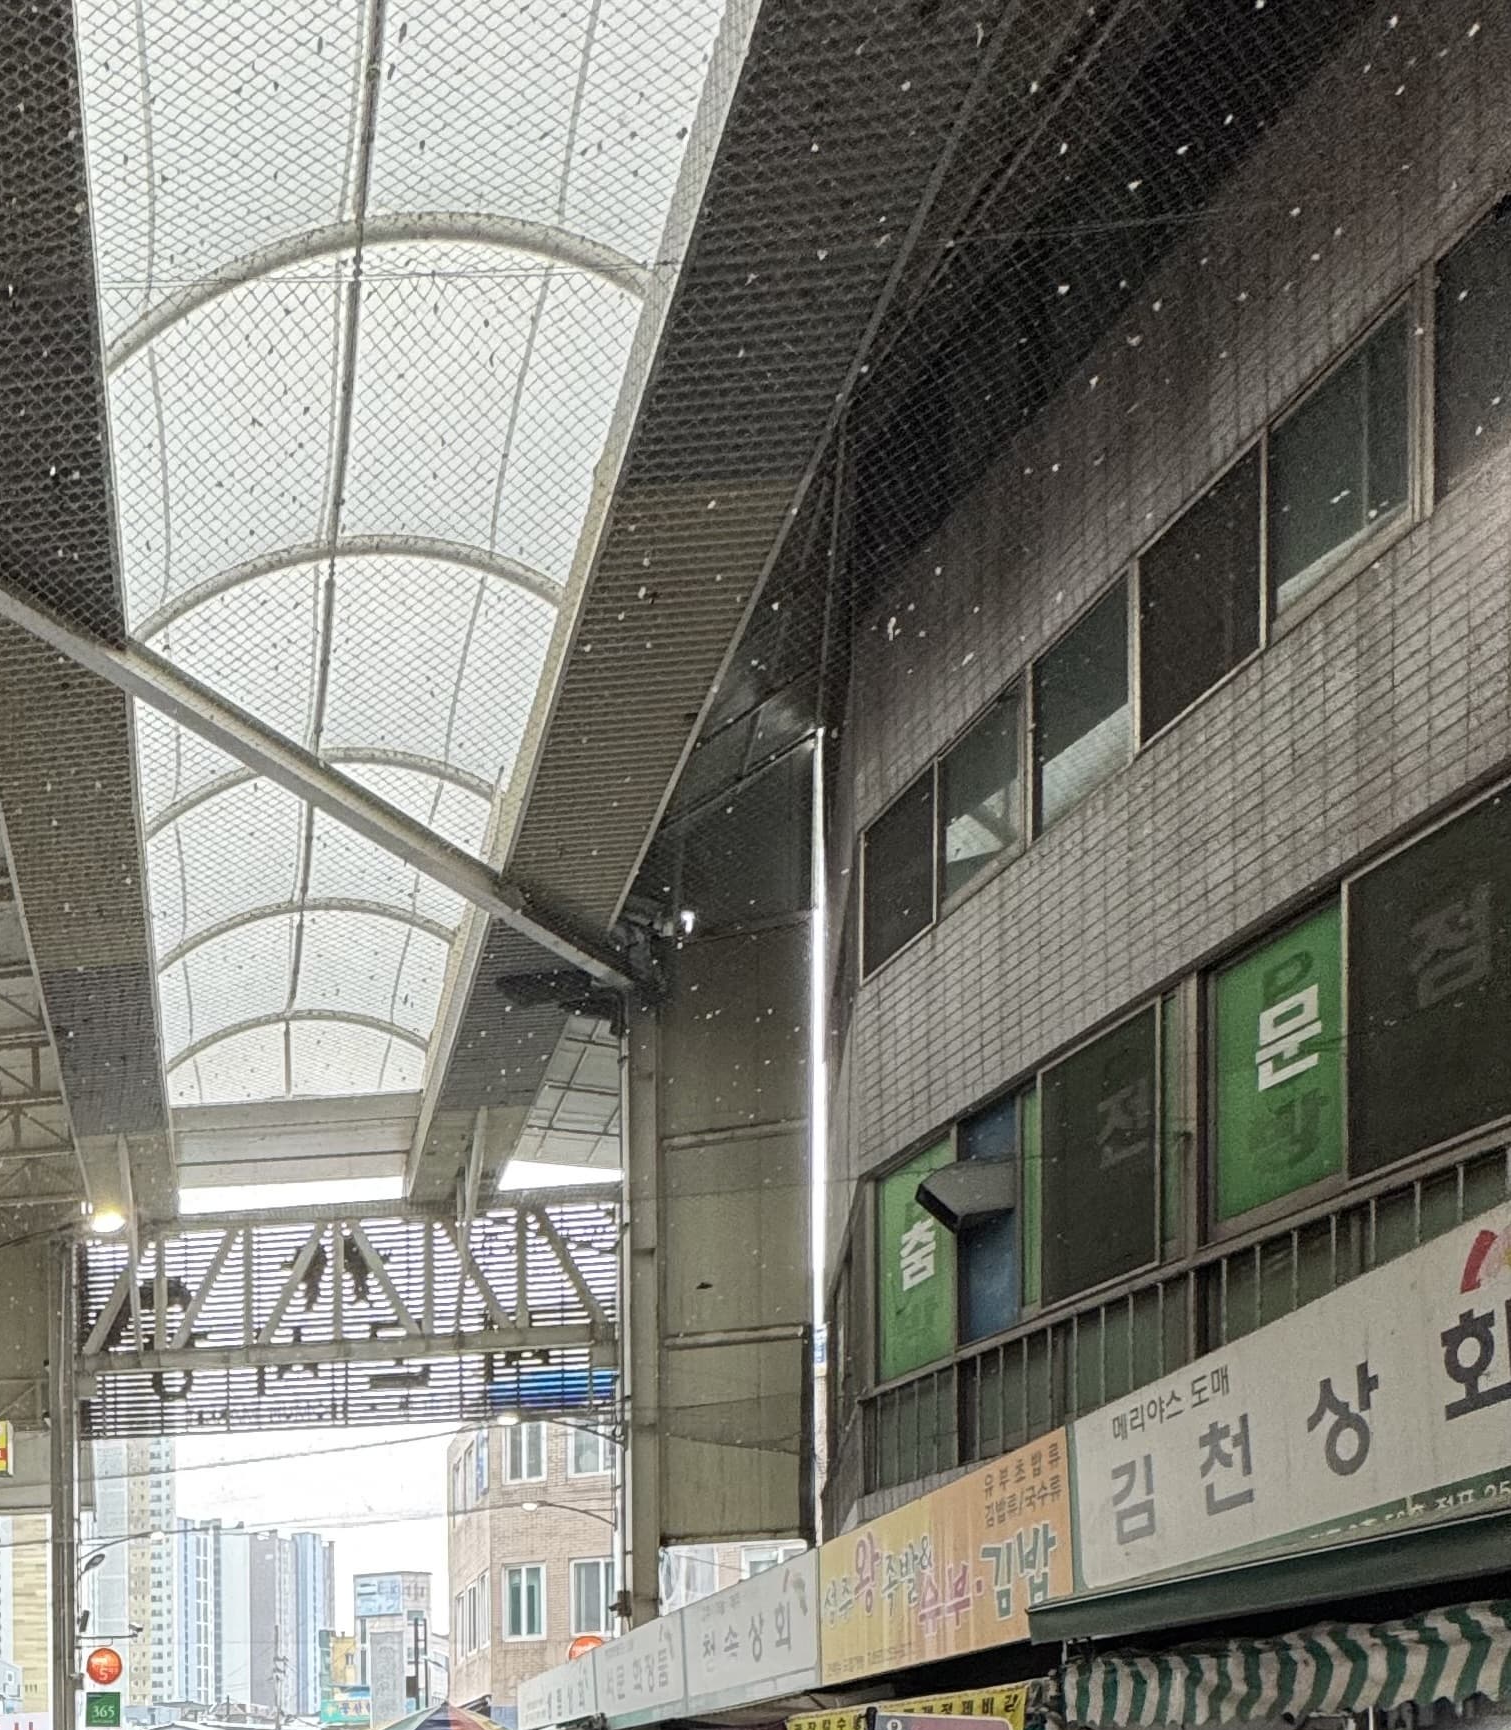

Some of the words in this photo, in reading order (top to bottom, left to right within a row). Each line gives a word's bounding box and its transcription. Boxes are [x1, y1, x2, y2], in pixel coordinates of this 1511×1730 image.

[1255, 984, 1322, 1092] 문
[1190, 1362, 1231, 1411] 도매
[91, 1704, 116, 1719] 365
